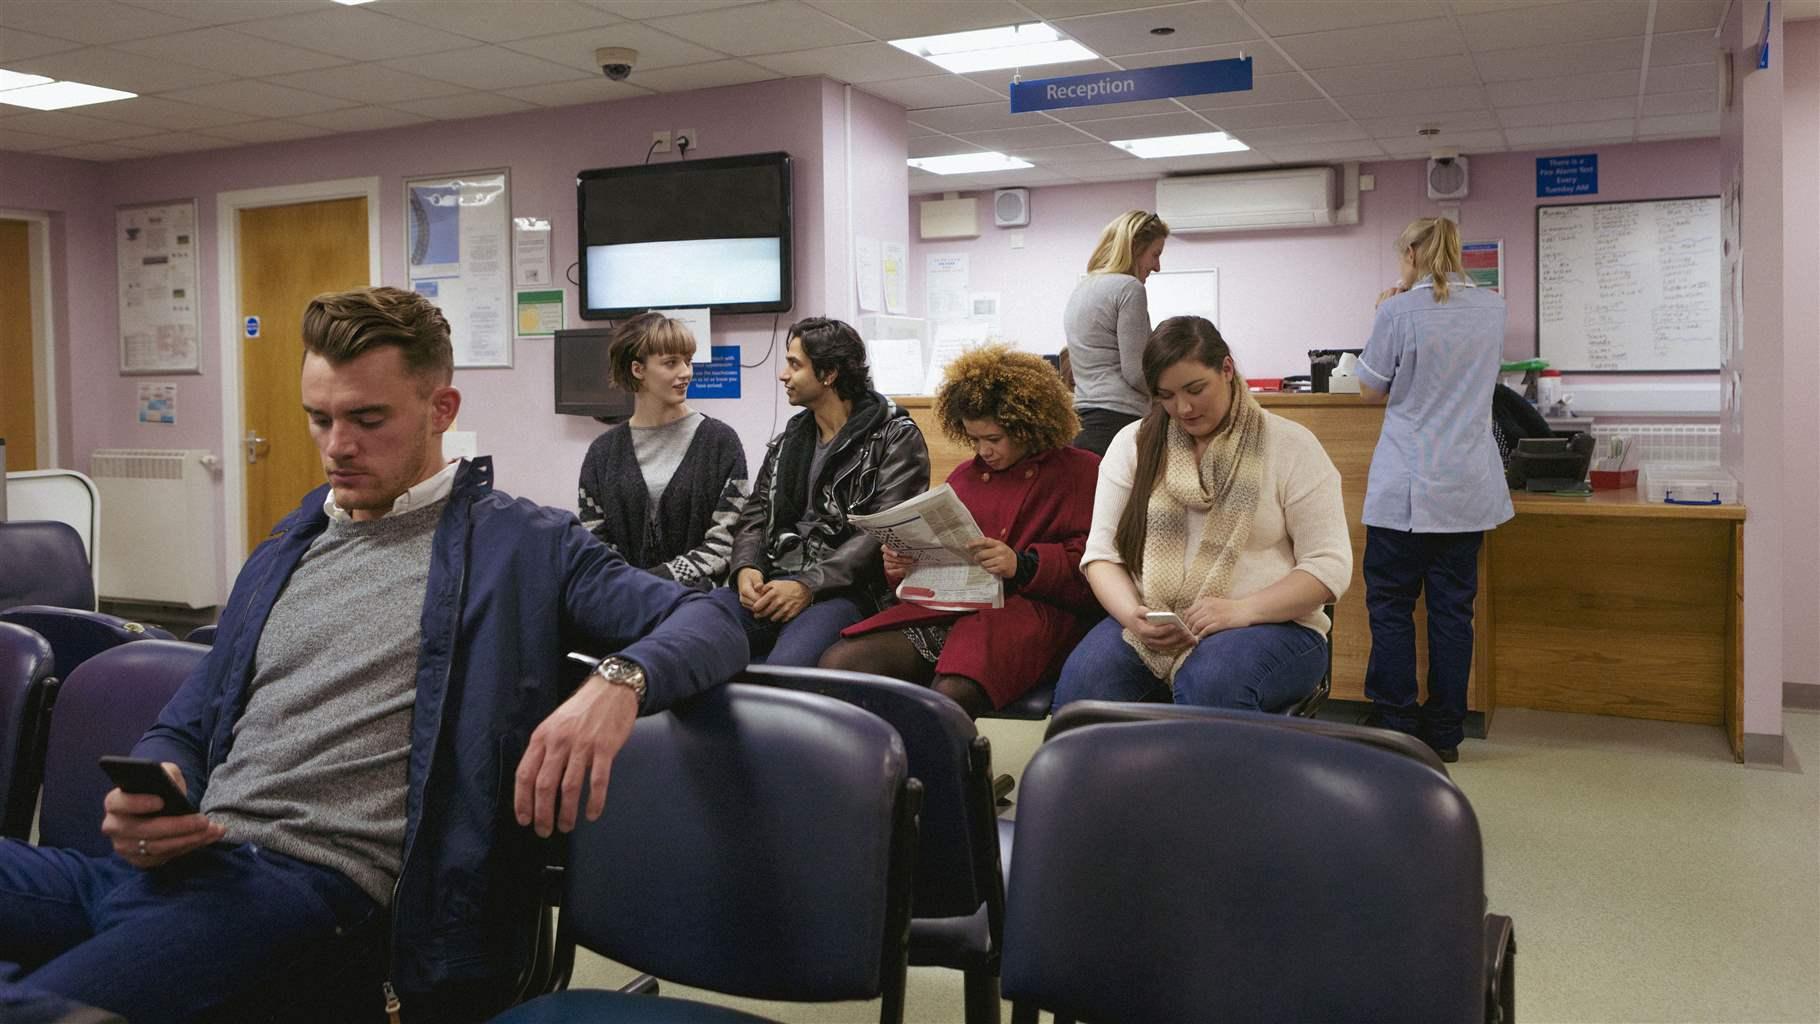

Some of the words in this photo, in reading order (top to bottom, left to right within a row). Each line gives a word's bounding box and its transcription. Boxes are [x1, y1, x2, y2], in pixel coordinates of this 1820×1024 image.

[1047, 77, 1134, 100] Reception
[1540, 168, 1554, 176] Fire
[1555, 167, 1577, 175] Alarm
[1556, 176, 1577, 184] Every
